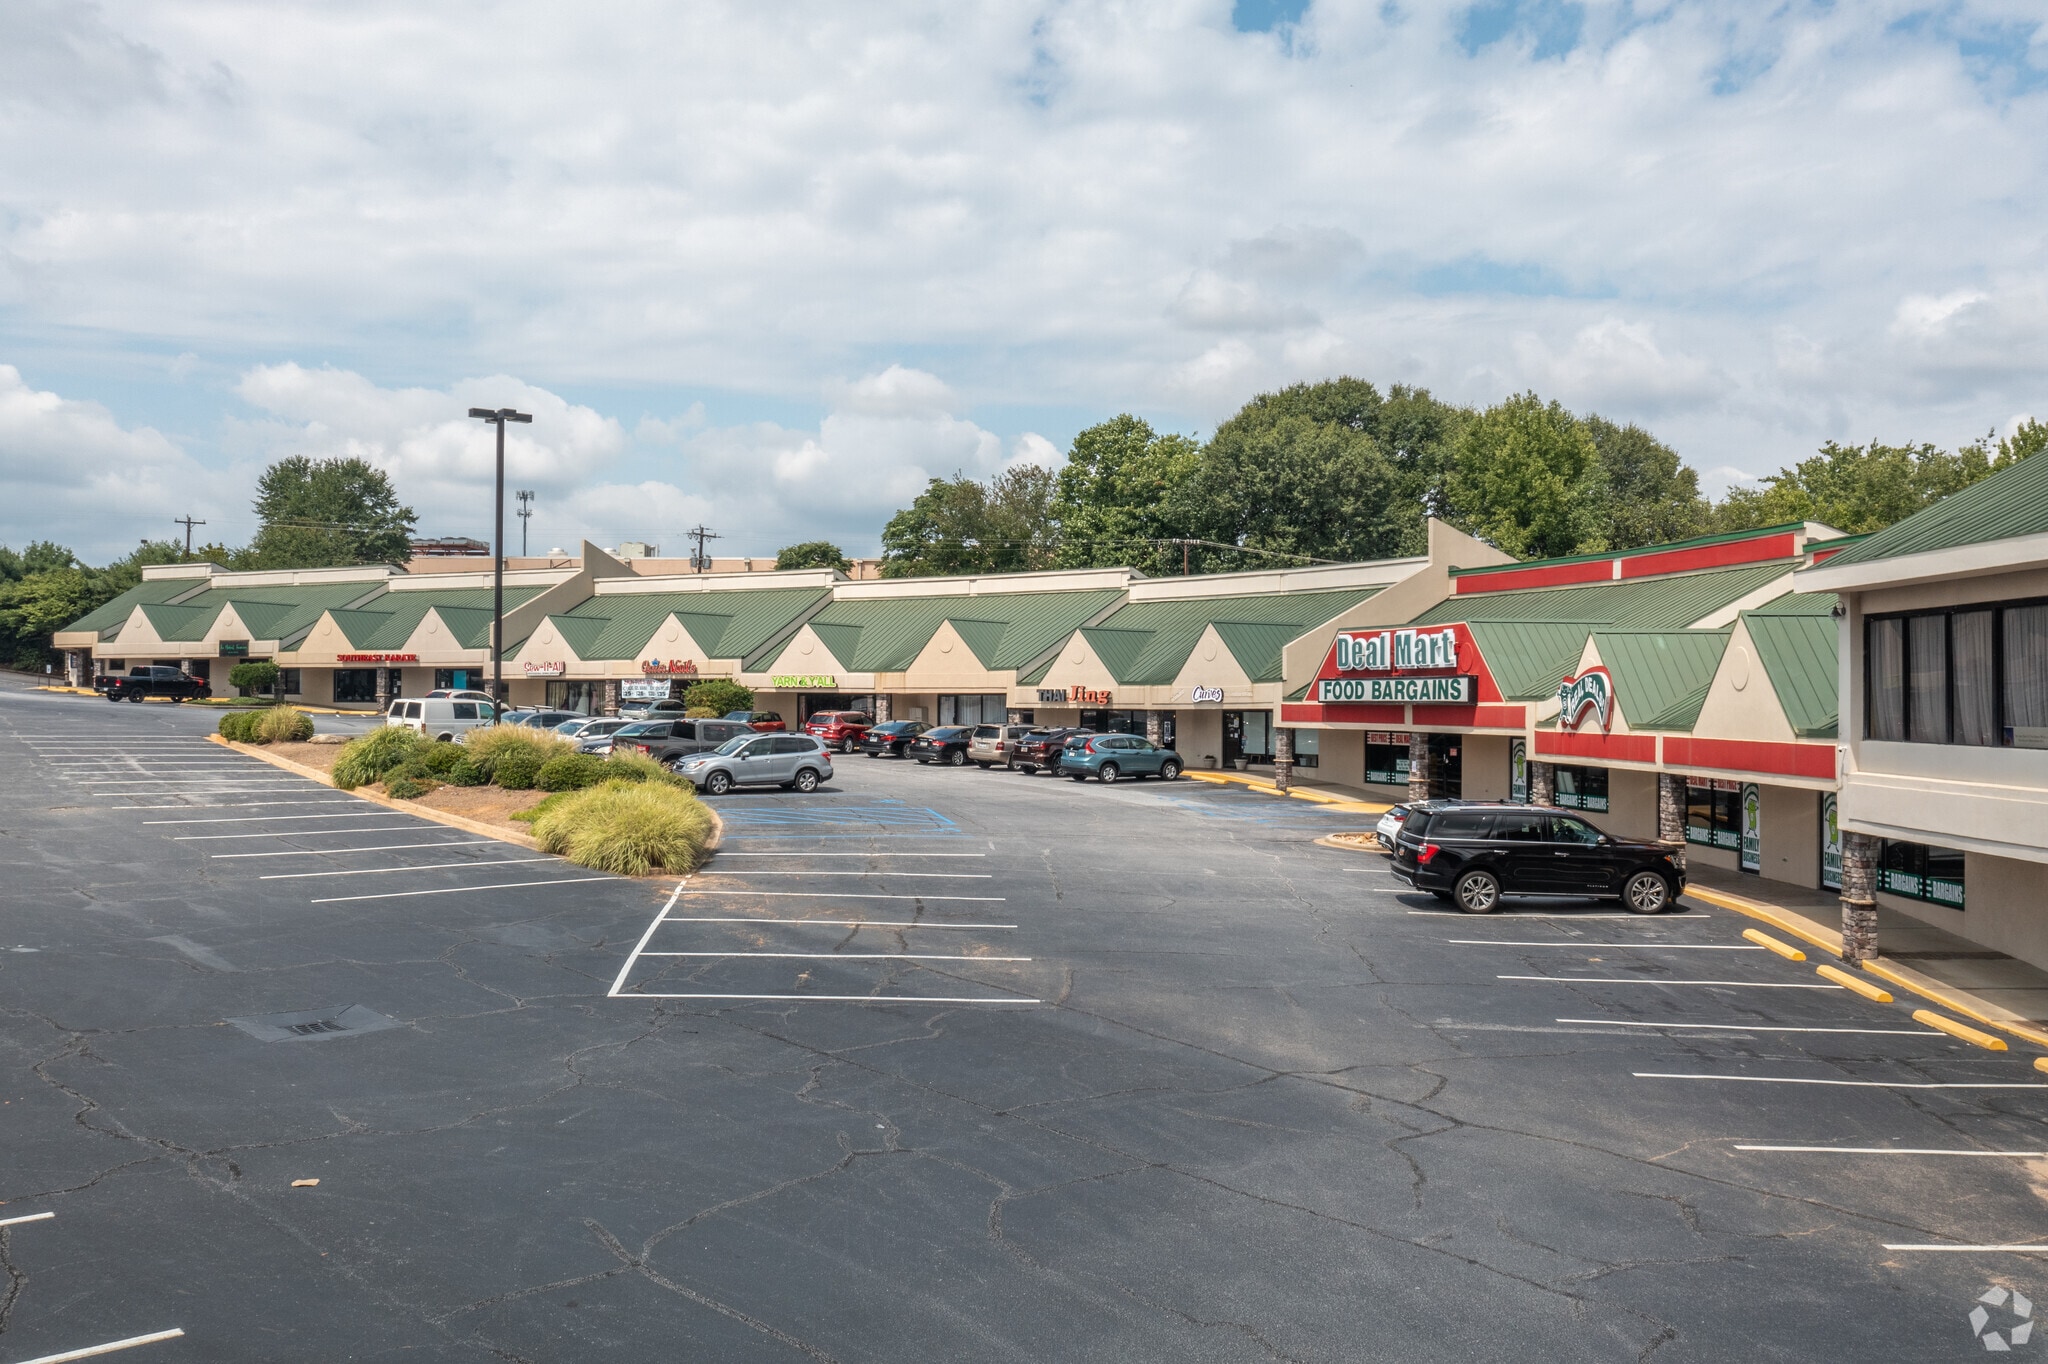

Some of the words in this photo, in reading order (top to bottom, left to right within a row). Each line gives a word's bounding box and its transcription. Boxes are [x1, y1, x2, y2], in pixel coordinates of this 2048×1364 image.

[337, 654, 382, 662] SOUTHEAST
[385, 654, 417, 662] KARATE
[1337, 633, 1390, 669] Deal
[1395, 630, 1456, 668] Mart
[772, 675, 798, 687] YARN
[800, 675, 808, 687] &
[809, 675, 836, 687] Y'ALL
[1324, 681, 1365, 700] FOOD
[1371, 679, 1461, 700] BARGAINS
[1037, 689, 1067, 702] THAI
[1067, 685, 1111, 705] Jing
[1193, 686, 1221, 701] Curves
[1717, 830, 1737, 848] BARGAINS
[1744, 836, 1760, 852] FAMILY
[1824, 852, 1842, 869] FAMILY
[1890, 872, 1919, 895] BARGAINS
[1932, 880, 1963, 904] BARGAINS
